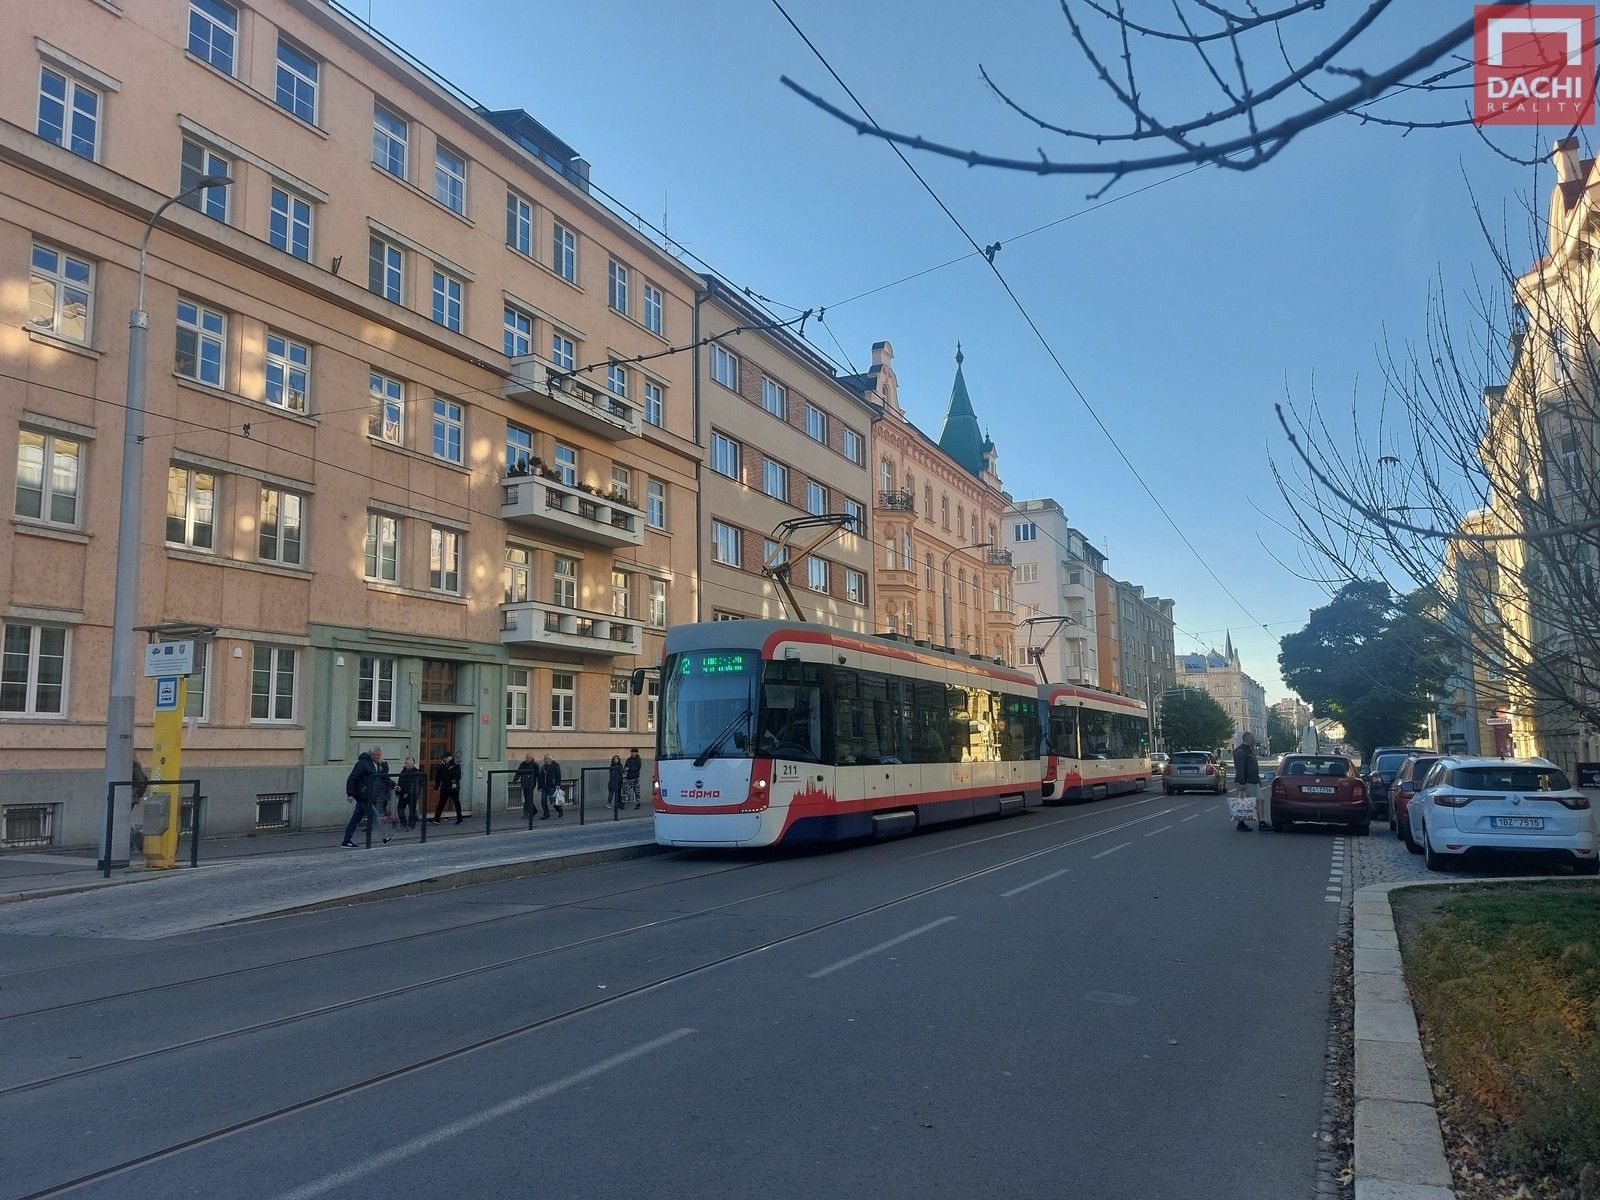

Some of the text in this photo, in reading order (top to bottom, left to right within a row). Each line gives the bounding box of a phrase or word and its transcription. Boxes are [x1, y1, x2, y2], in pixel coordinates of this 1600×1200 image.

[681, 657, 690, 674] 2
[783, 764, 797, 775] 211
[1498, 818, 1540, 827] 1BZ 7515
